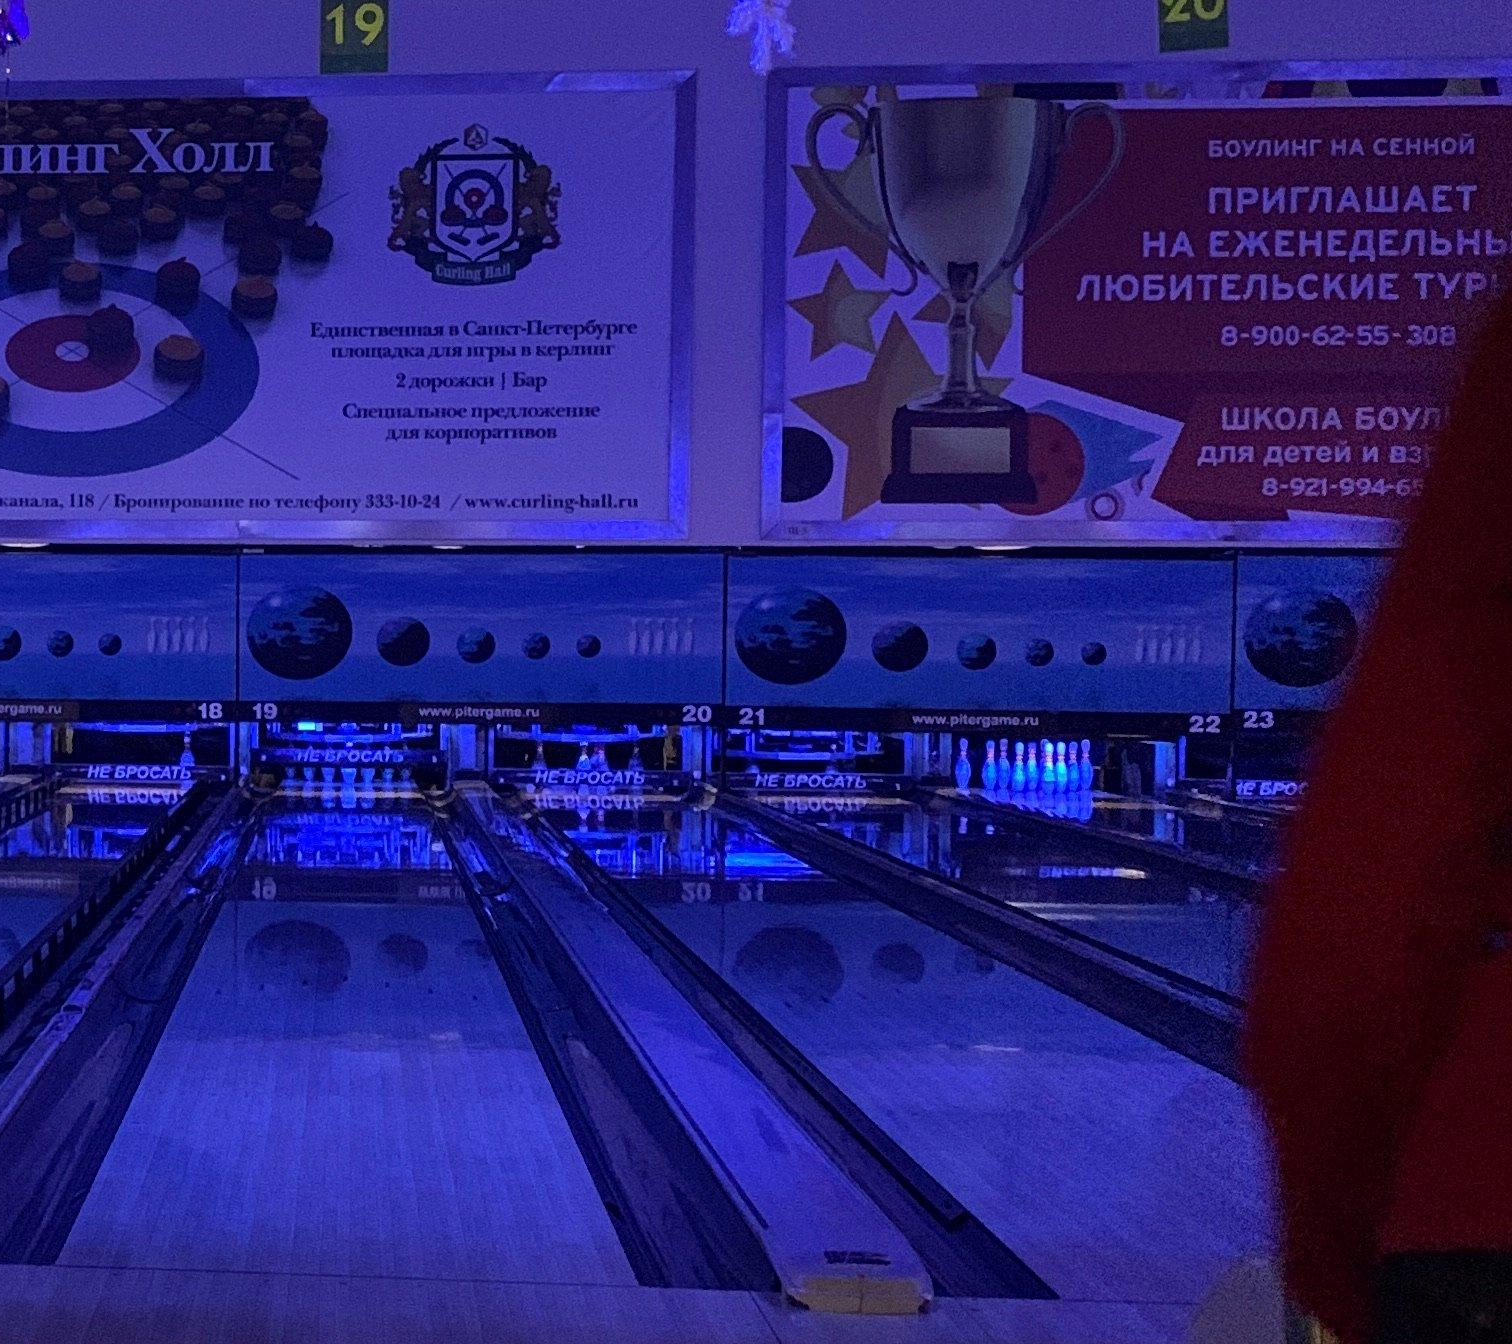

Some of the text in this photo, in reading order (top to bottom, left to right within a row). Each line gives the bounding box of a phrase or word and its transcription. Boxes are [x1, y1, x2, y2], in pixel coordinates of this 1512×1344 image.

[326, 4, 383, 45] 19
[129, 128, 274, 174] Холл
[1208, 134, 1475, 157] БОУЛИНГ НА СЕННОЙ
[1208, 186, 1477, 214] ПРИГЛАШАЕТ
[1143, 231, 1194, 257] НА
[436, 263, 511, 282] Curling Hall
[1076, 274, 1399, 301] ЛЮБИТЕЛЬСКИЕ
[310, 319, 637, 340] Единственная в Санкт-Петербурге
[1221, 326, 1456, 346] 8-900-62-55-308
[331, 343, 615, 362] площадка для игры в керлинг
[396, 372, 547, 392] 2 дорожки Бар
[342, 403, 599, 422] Специальное предложение
[1222, 408, 1342, 431] ШКОЛА
[386, 427, 557, 444] для корпоративов
[1197, 446, 1254, 466] для
[1263, 442, 1350, 466] детей
[1361, 447, 1378, 462] и
[69, 494, 94, 508] 118
[114, 494, 244, 513] Бронирование
[249, 497, 270, 508] по
[275, 495, 360, 513] телефону
[366, 495, 440, 508] 333-10-24
[465, 494, 639, 512] www.curling-hall.ru
[197, 702, 223, 718] 18
[252, 704, 277, 719] 19
[419, 705, 540, 720] www.pitergame.ru
[682, 705, 712, 723] 20
[738, 708, 765, 725] 21
[1243, 711, 1274, 728] 23
[912, 713, 1039, 728] www.pitergame.ru
[1190, 715, 1220, 733] 22
[88, 765, 191, 779] НЕ БРОСАТЬ
[535, 769, 645, 785] НЕ БРОСАТЬ
[755, 773, 866, 789] НЕ БРОСАТЬ
